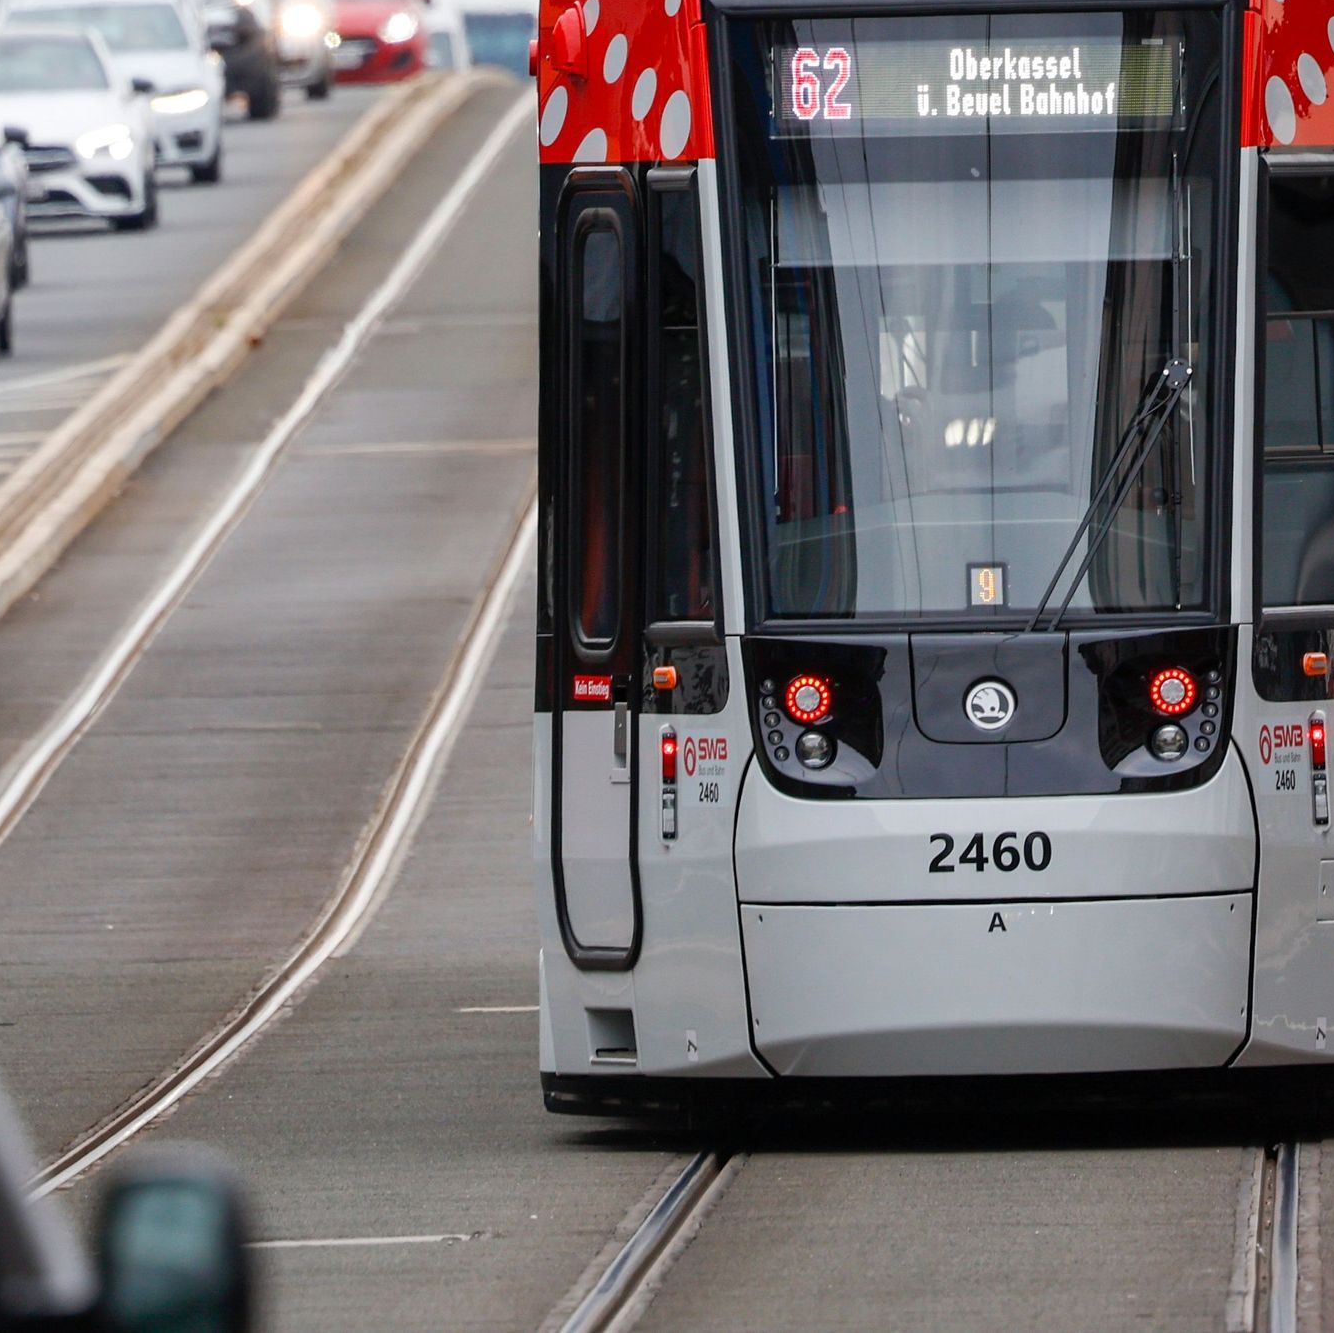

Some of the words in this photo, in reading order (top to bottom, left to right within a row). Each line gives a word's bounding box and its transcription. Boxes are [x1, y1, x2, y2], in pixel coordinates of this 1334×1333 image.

[949, 47, 1082, 80] Oberkassel
[791, 47, 851, 119] 62
[917, 84, 938, 116] ü.
[1020, 82, 1116, 115] Bahnhof
[979, 569, 995, 602] 9
[698, 738, 728, 760] SWB
[1273, 725, 1303, 748] SWB
[699, 782, 719, 803] 2460
[1276, 769, 1296, 791] 2460
[929, 831, 1052, 873] 2460
[988, 912, 1007, 933] A
